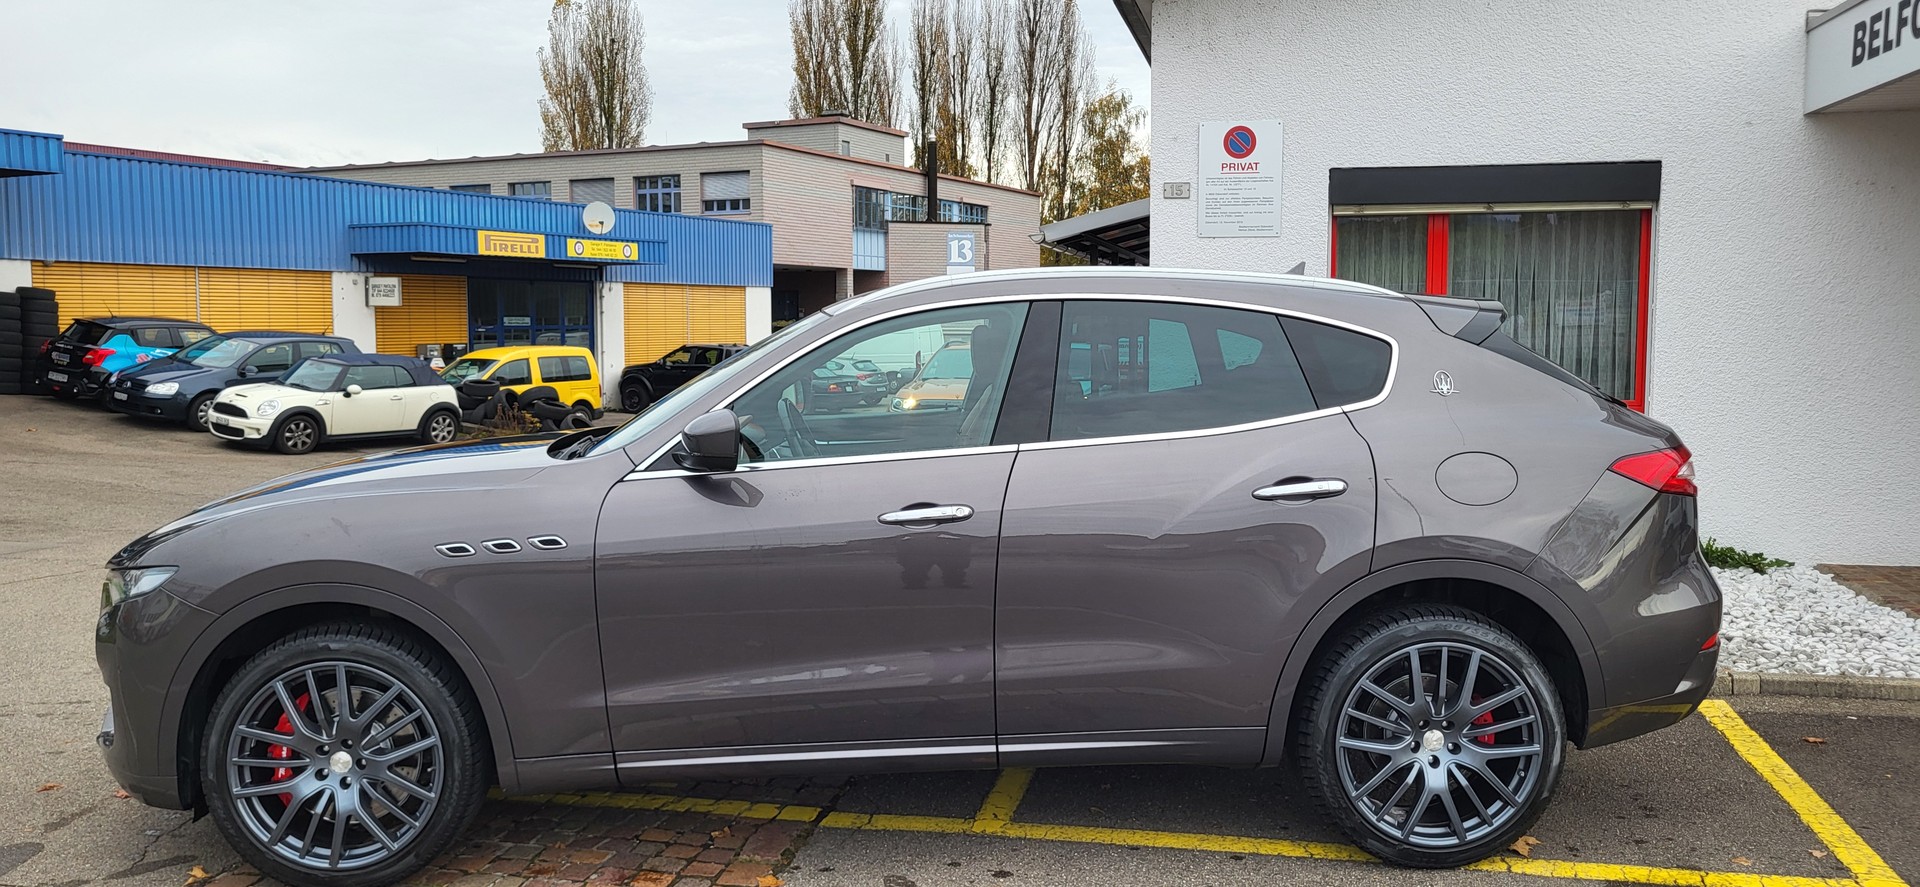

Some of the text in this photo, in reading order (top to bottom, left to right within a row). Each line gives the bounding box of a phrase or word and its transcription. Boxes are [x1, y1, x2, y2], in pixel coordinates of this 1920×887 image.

[1221, 162, 1260, 171] PRIVAT
[1170, 184, 1184, 196] 15
[485, 234, 539, 254] PIRELLI
[948, 239, 973, 263] 13
